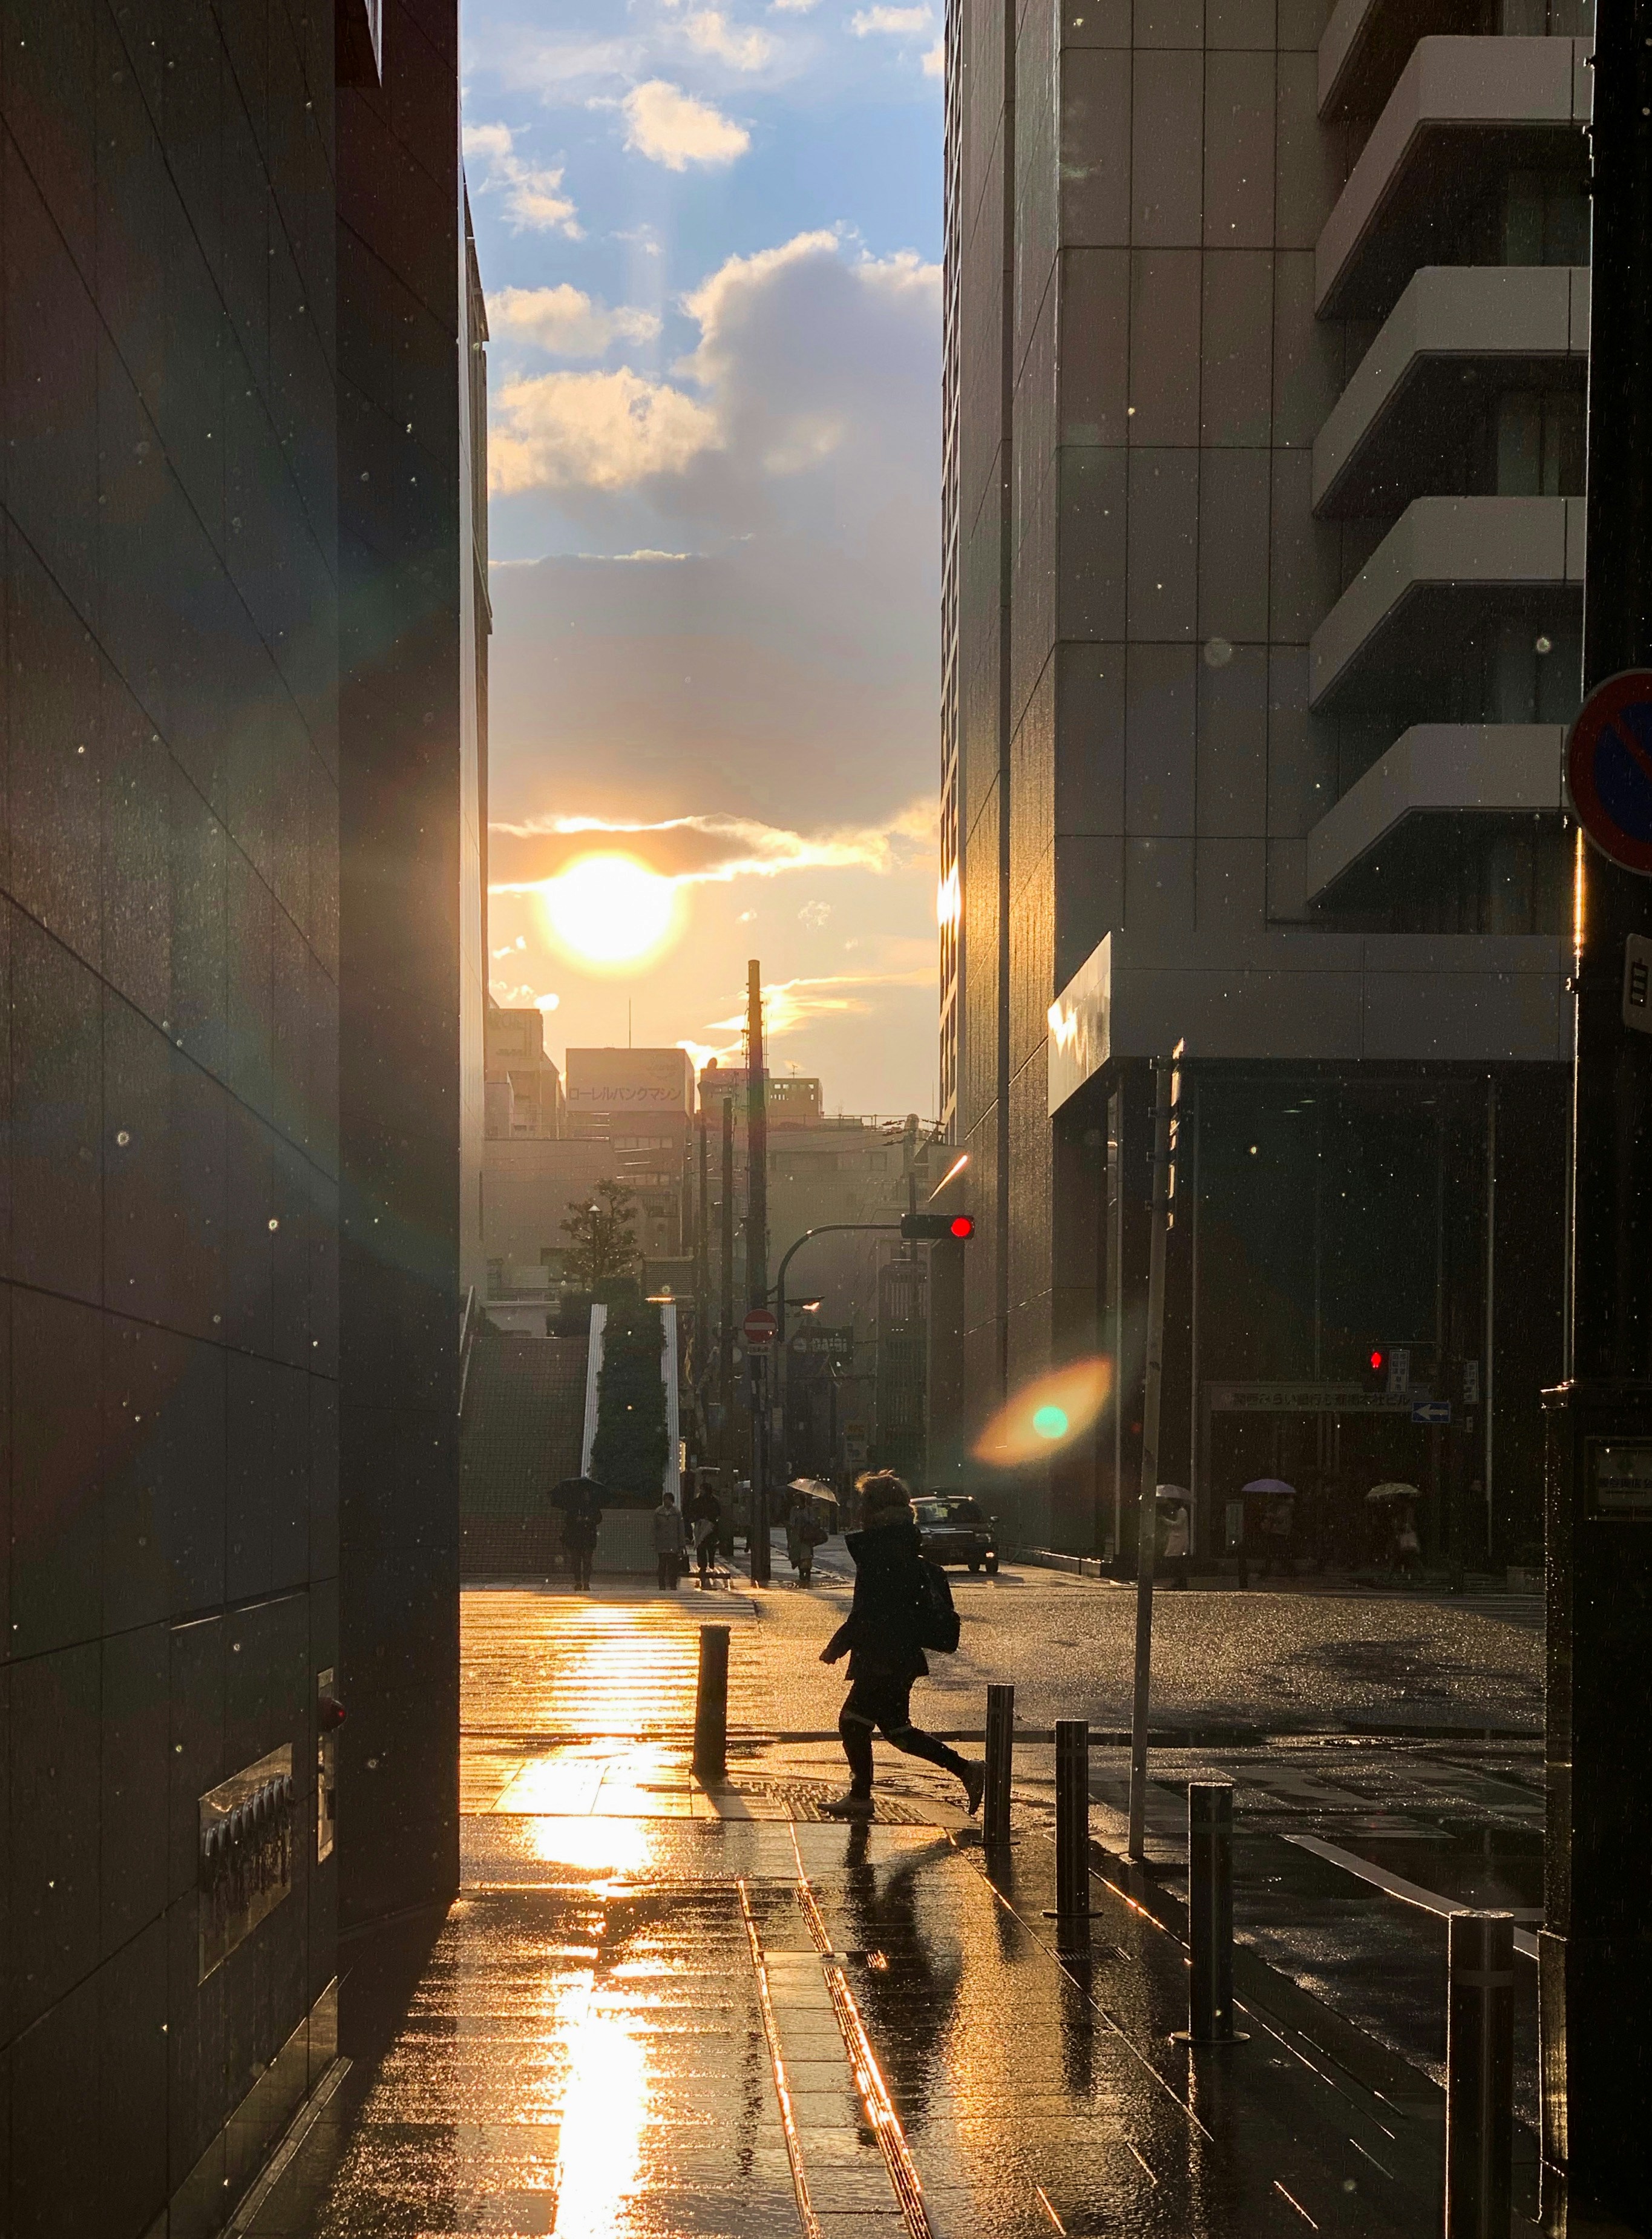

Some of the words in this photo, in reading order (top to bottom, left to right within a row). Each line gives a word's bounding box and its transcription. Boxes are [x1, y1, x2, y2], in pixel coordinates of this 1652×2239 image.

[569, 1087, 681, 1101] ローレルバンクマシン
